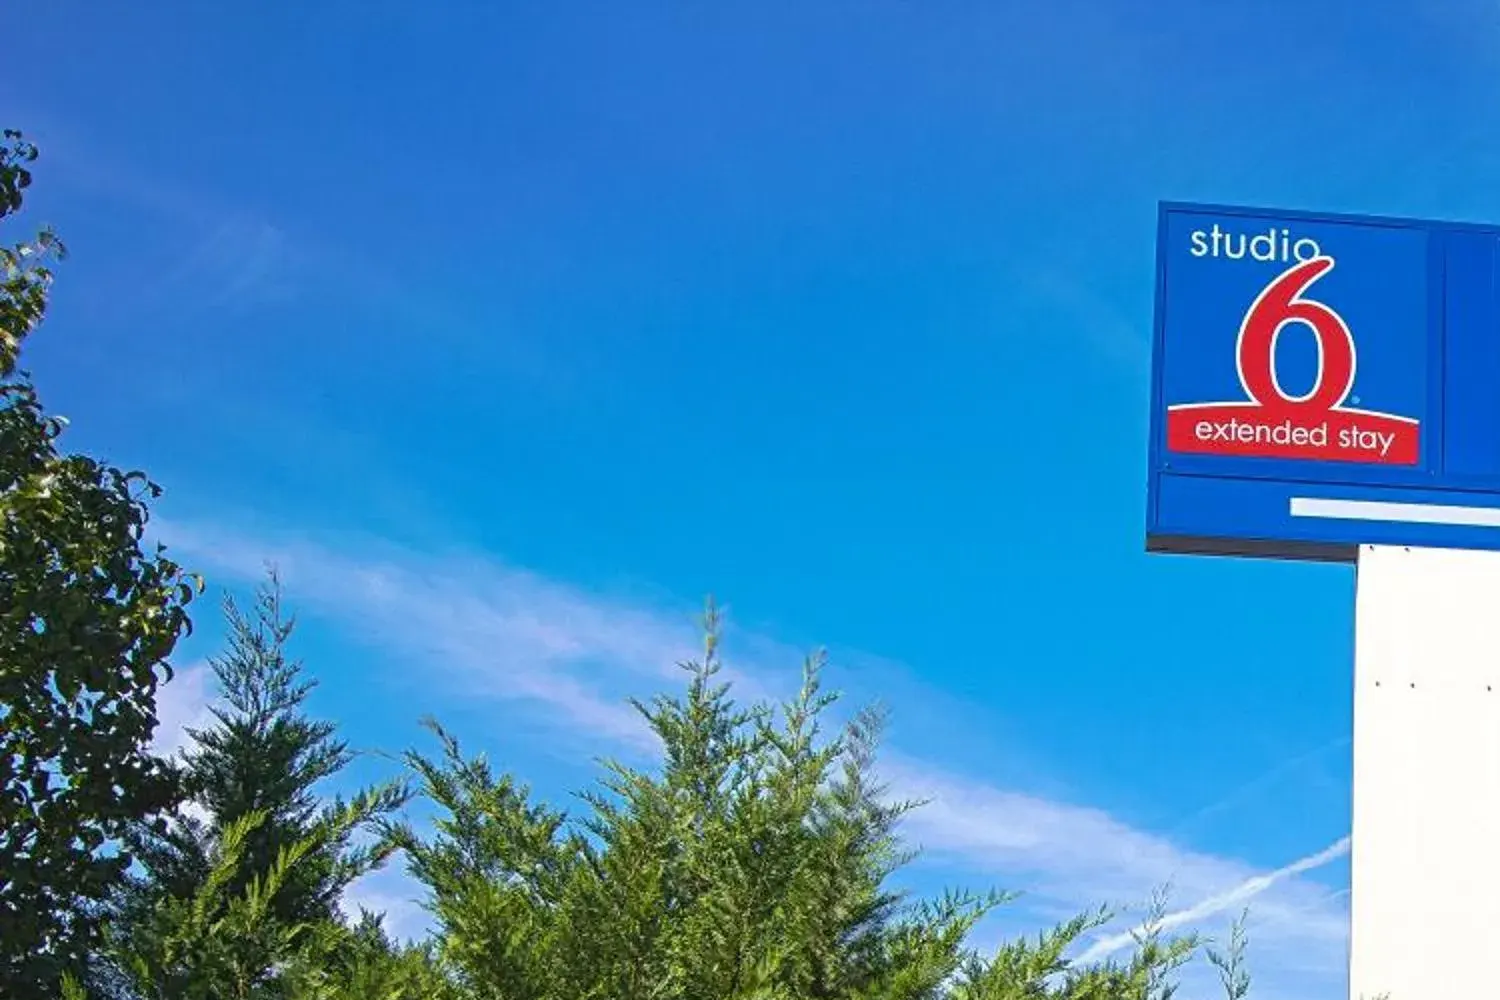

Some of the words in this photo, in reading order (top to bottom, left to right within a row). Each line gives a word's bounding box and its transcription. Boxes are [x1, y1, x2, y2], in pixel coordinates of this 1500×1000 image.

[1190, 224, 1321, 263] studio
[1235, 255, 1357, 409] 6
[1194, 417, 1328, 447] extended
[1338, 425, 1396, 457] stay
